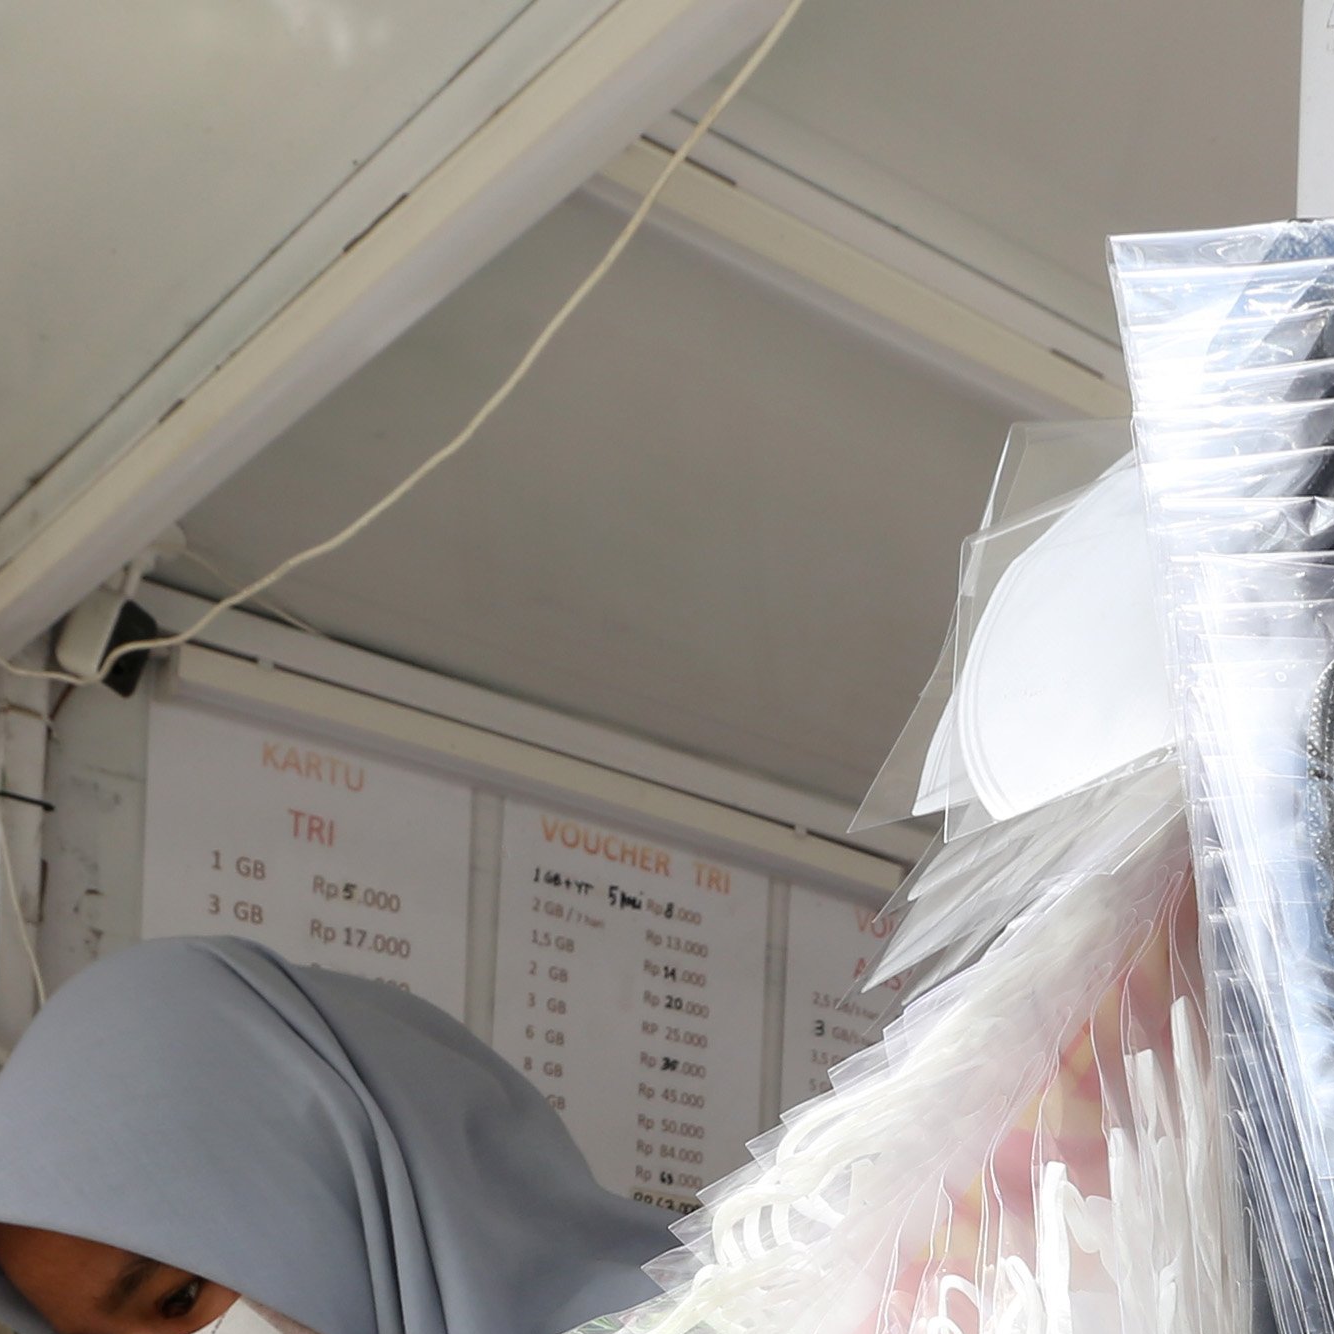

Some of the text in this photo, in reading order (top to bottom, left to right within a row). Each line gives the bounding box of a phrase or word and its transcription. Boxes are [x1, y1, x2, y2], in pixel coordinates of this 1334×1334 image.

[261, 741, 366, 792] KARTU
[288, 808, 336, 847] TRI
[540, 814, 732, 895] VOUCHER TRI
[211, 850, 267, 880] 1 GB
[208, 894, 264, 925] 3 GB
[309, 918, 411, 958] Rp 17.000
[555, 935, 575, 953] GB
[645, 929, 662, 947] Rp
[548, 965, 569, 983] GB
[644, 959, 660, 977] Rp
[546, 997, 567, 1015] GB
[643, 990, 660, 1007] Rp
[545, 1029, 565, 1046] GB
[639, 1051, 657, 1069] Rp
[543, 1061, 563, 1078] GB
[638, 1082, 656, 1100] Rp
[637, 1113, 655, 1131] Rp
[636, 1139, 654, 1157] Rp
[635, 1165, 653, 1182] Rp
